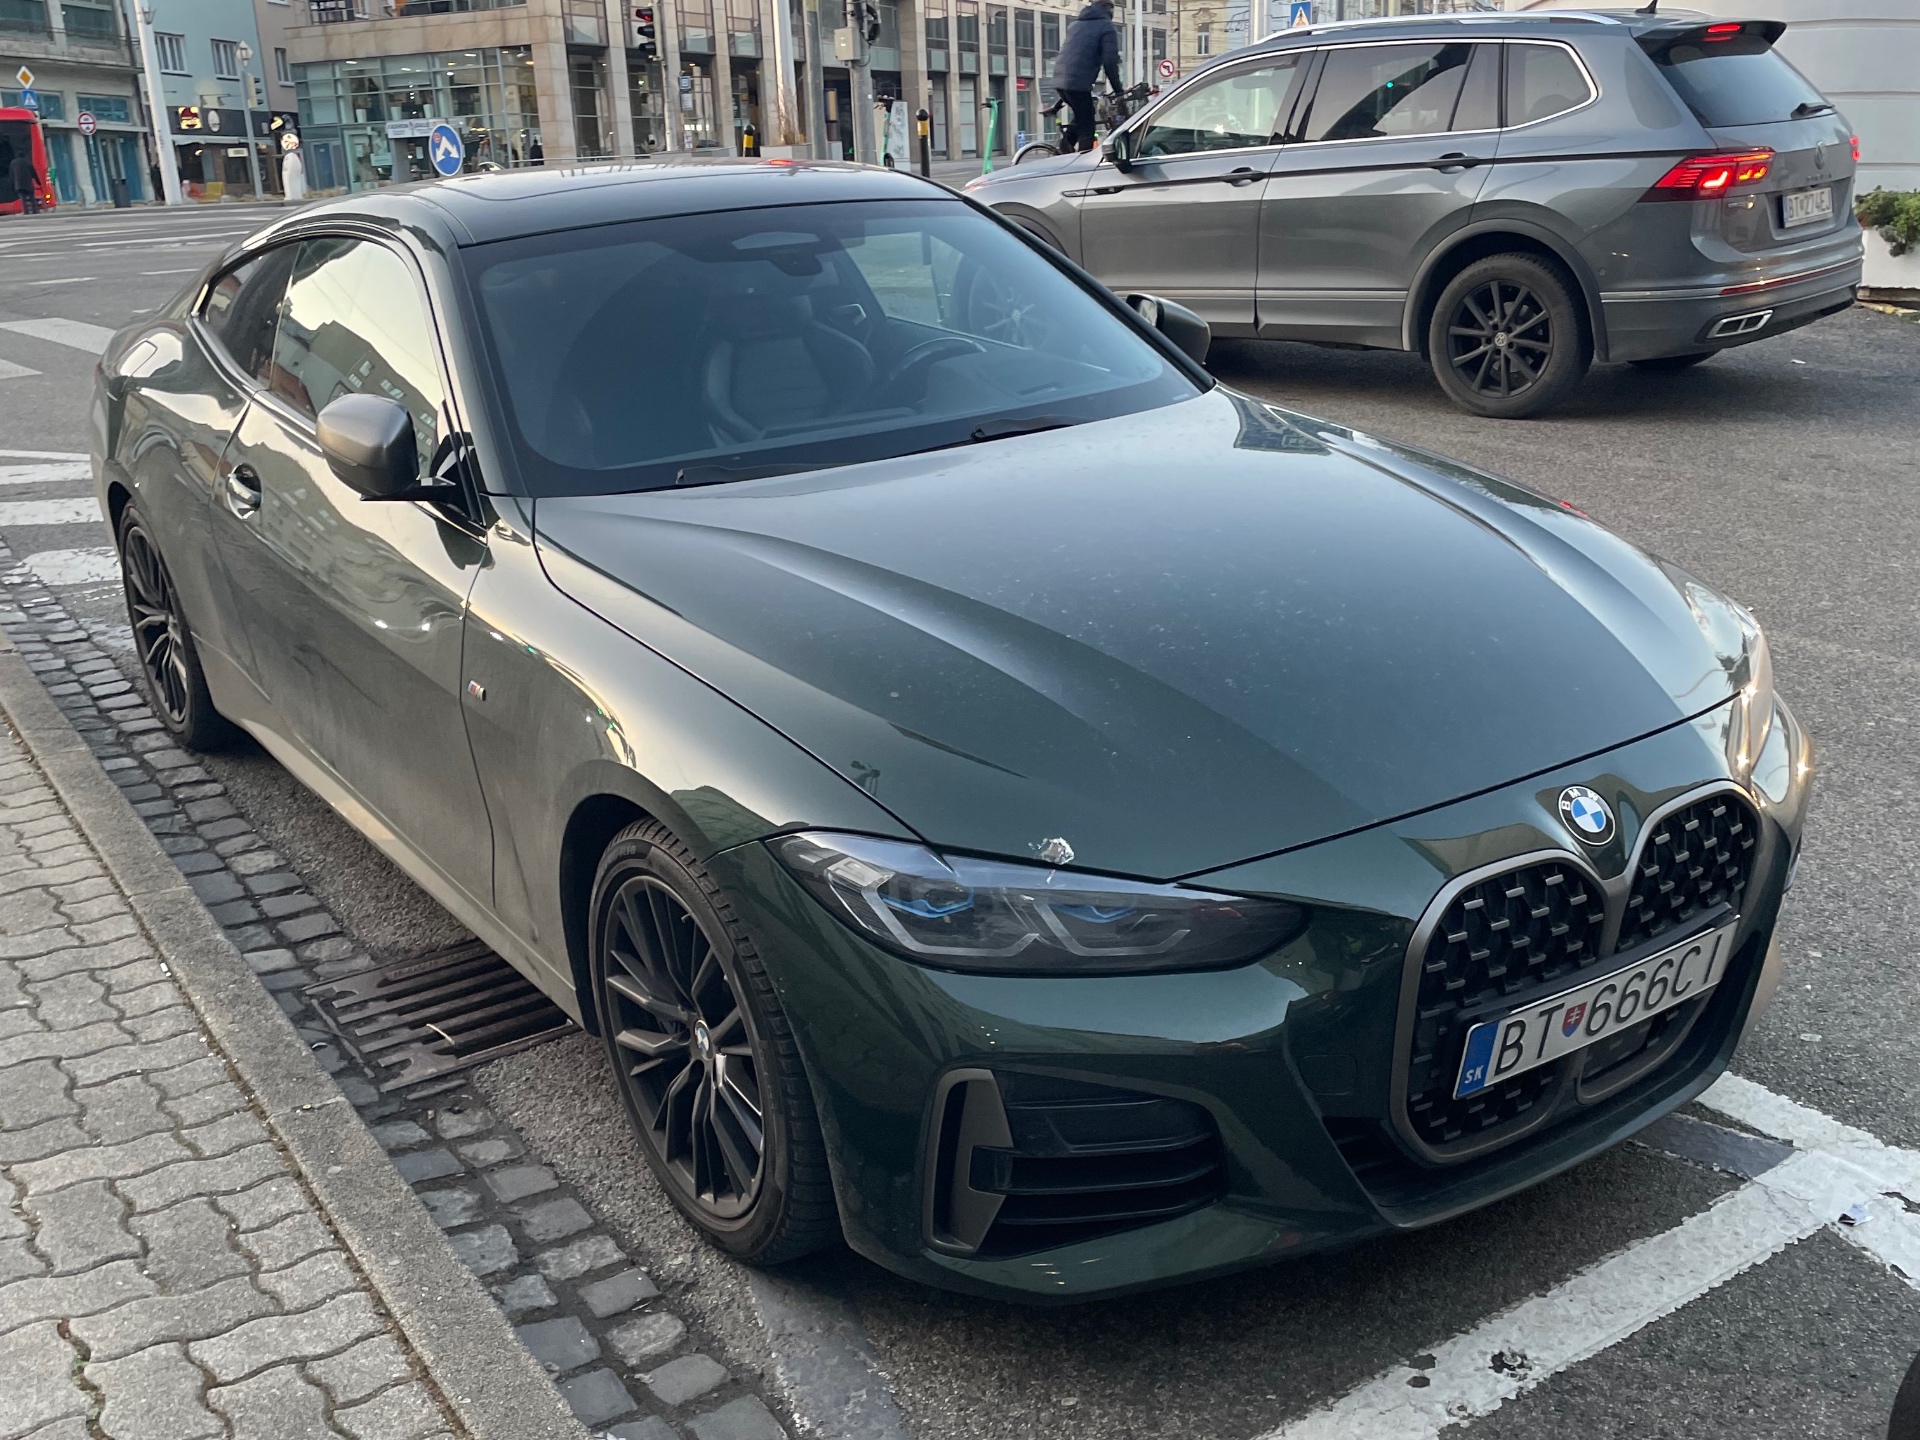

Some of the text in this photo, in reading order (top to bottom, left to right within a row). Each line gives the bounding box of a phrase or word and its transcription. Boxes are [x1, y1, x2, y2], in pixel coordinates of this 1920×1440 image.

[1561, 788, 1599, 811] BMW
[1494, 933, 1723, 1076] BT 666CI
[1464, 1065, 1484, 1084] SK
